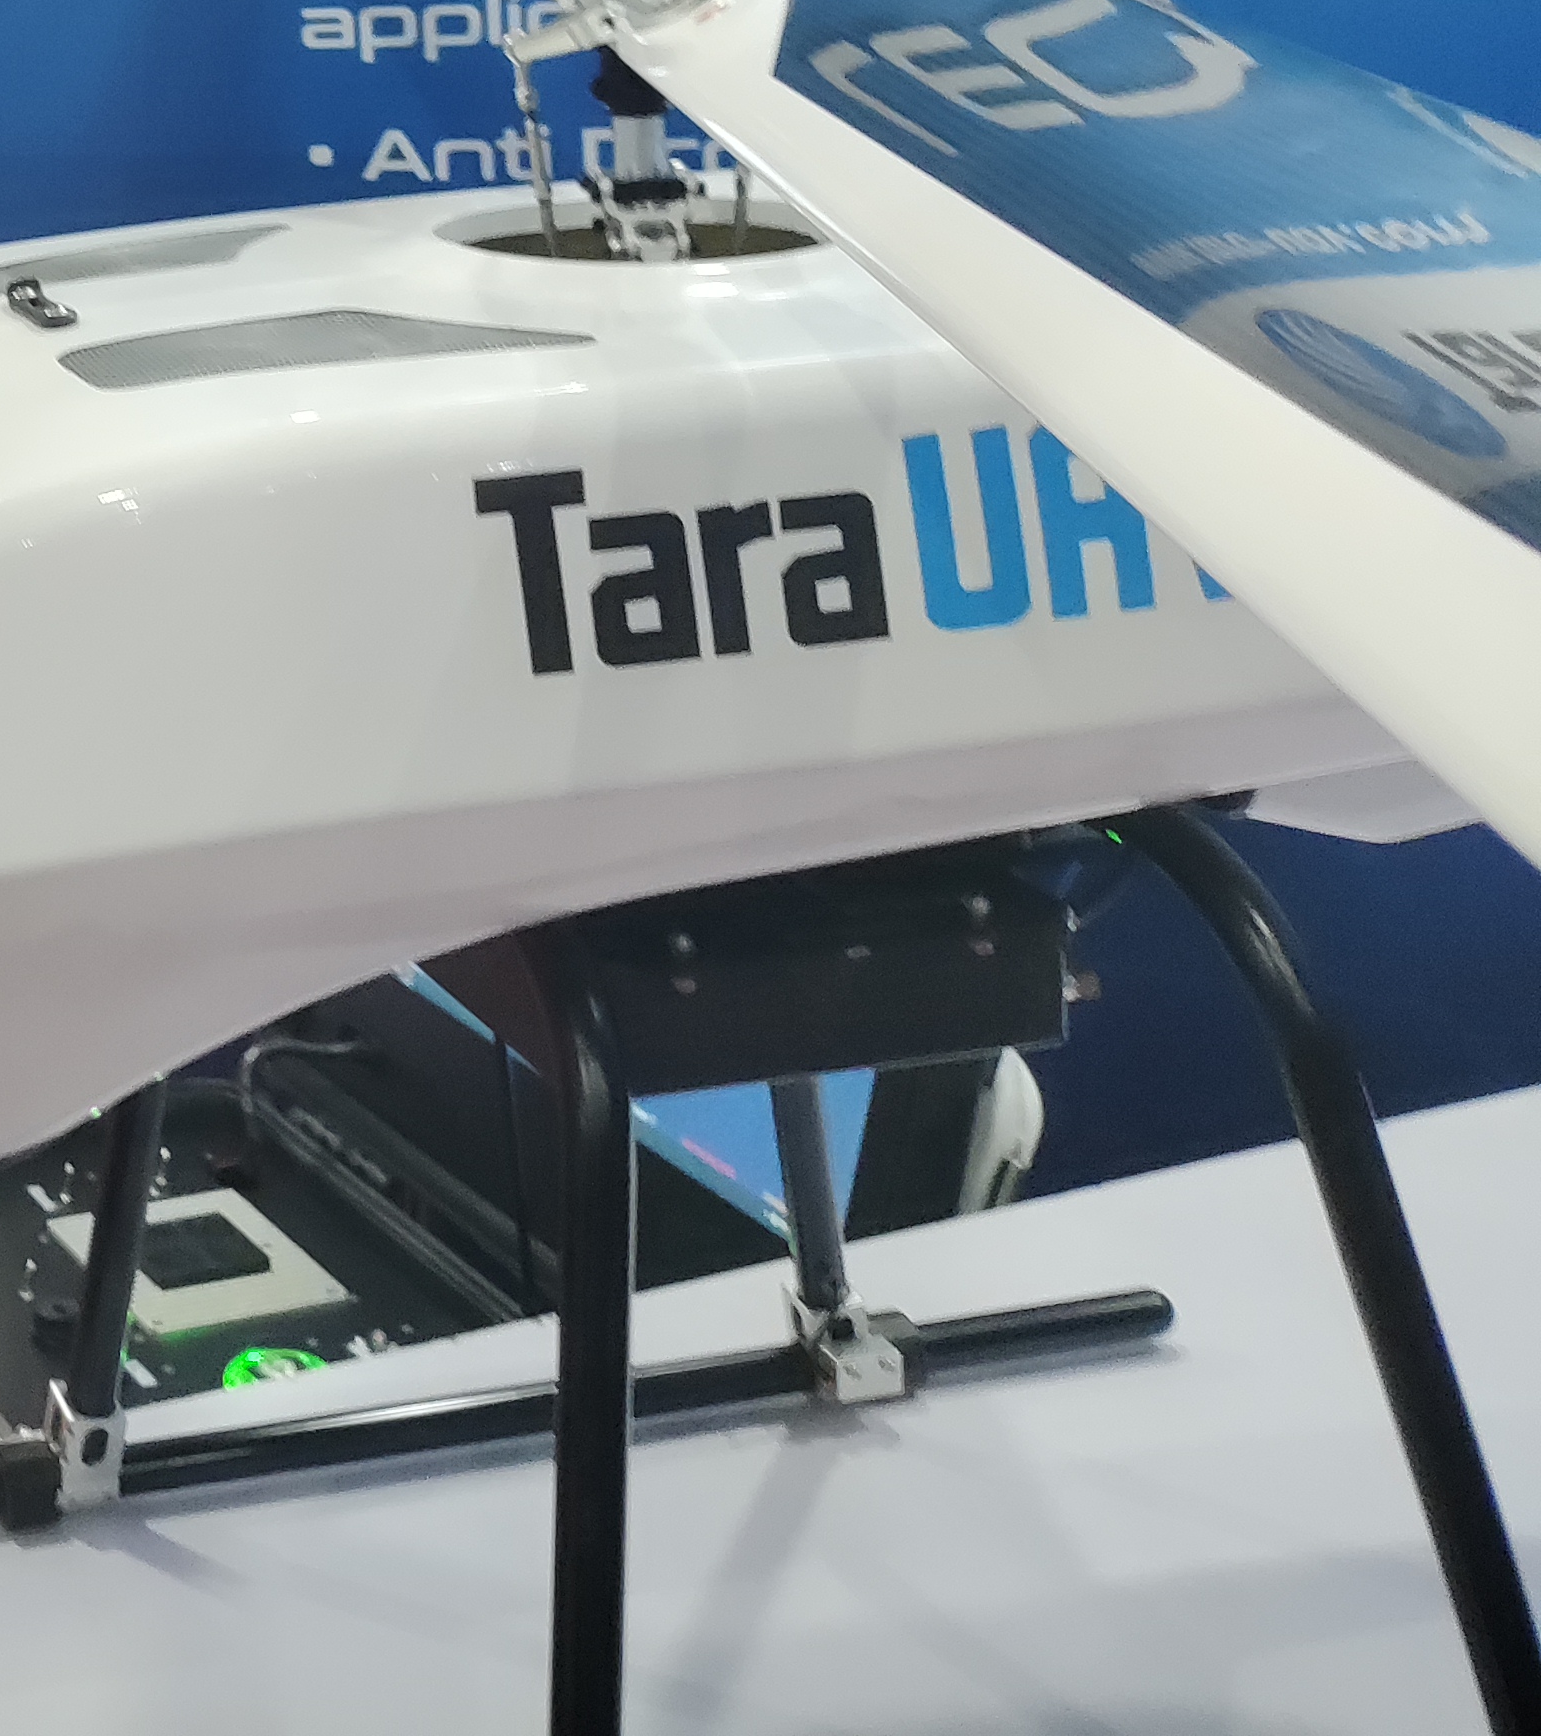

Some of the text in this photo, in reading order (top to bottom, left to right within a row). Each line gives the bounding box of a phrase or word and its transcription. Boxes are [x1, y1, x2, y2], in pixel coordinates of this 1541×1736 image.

[362, 124, 553, 182] Anti
[473, 421, 1235, 676] Tara UA
